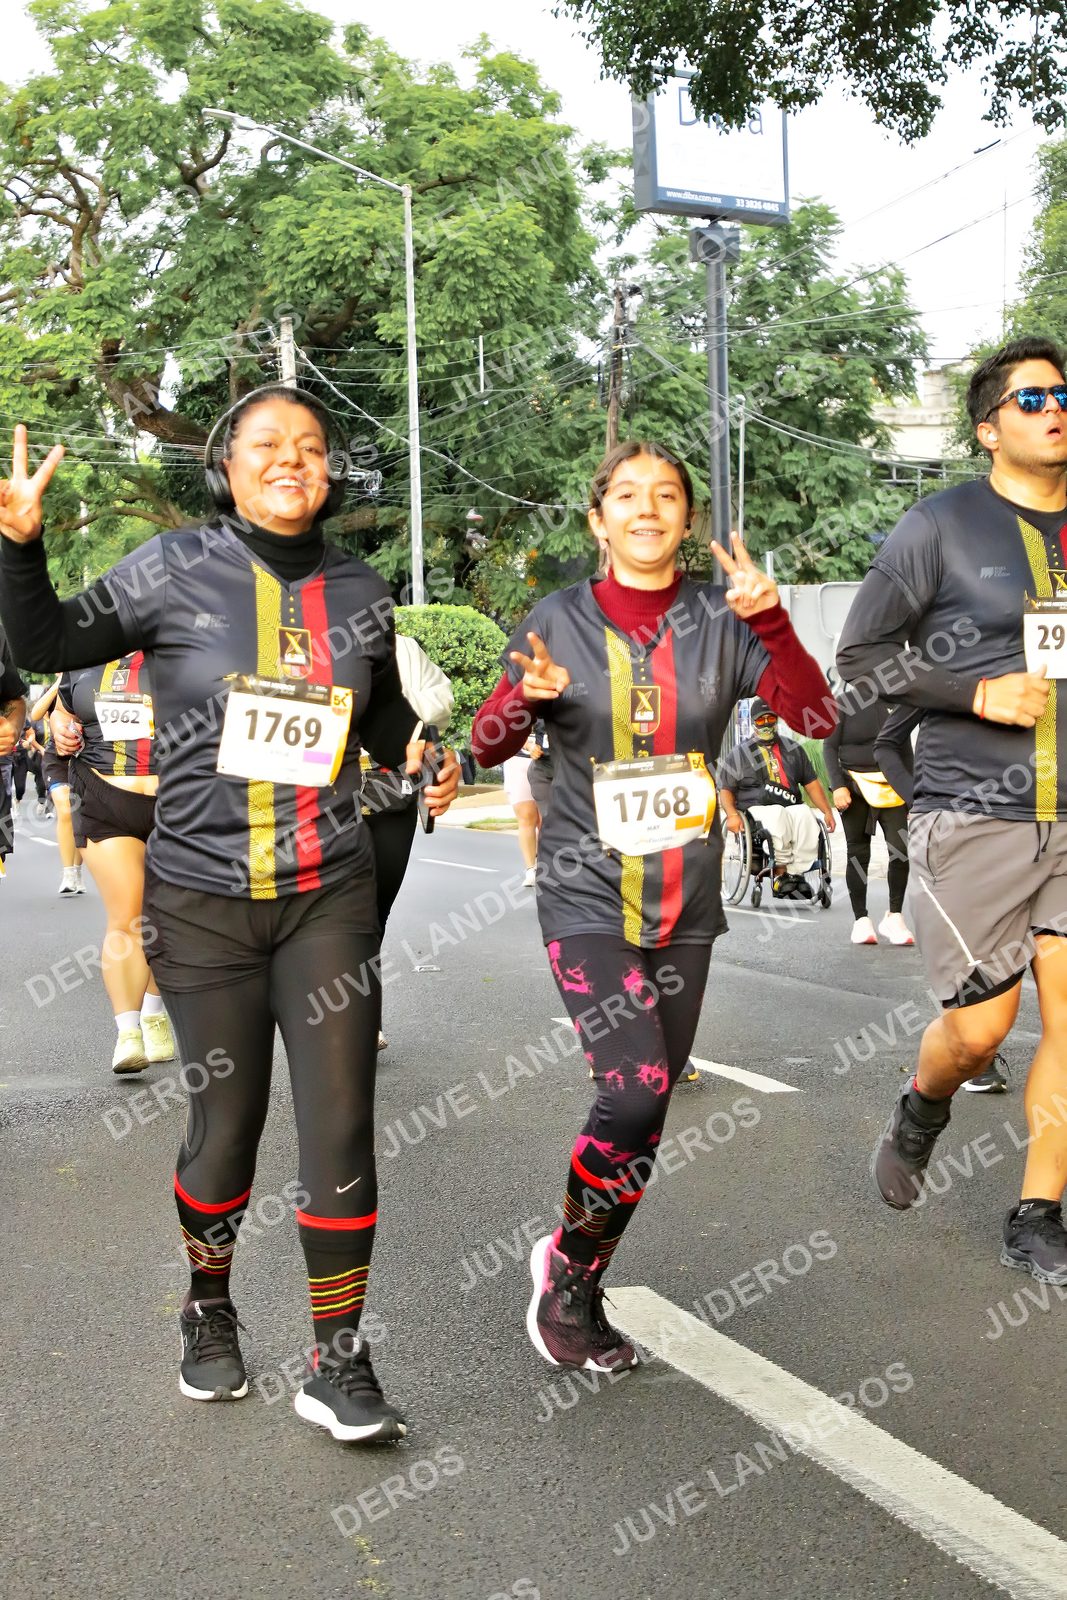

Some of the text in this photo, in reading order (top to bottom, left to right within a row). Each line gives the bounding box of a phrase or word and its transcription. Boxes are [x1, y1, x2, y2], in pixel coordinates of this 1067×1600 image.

[1037, 624, 1065, 650] 29
[100, 709, 140, 724] 5962
[245, 709, 322, 749] 1769
[613, 785, 691, 823] 1768
